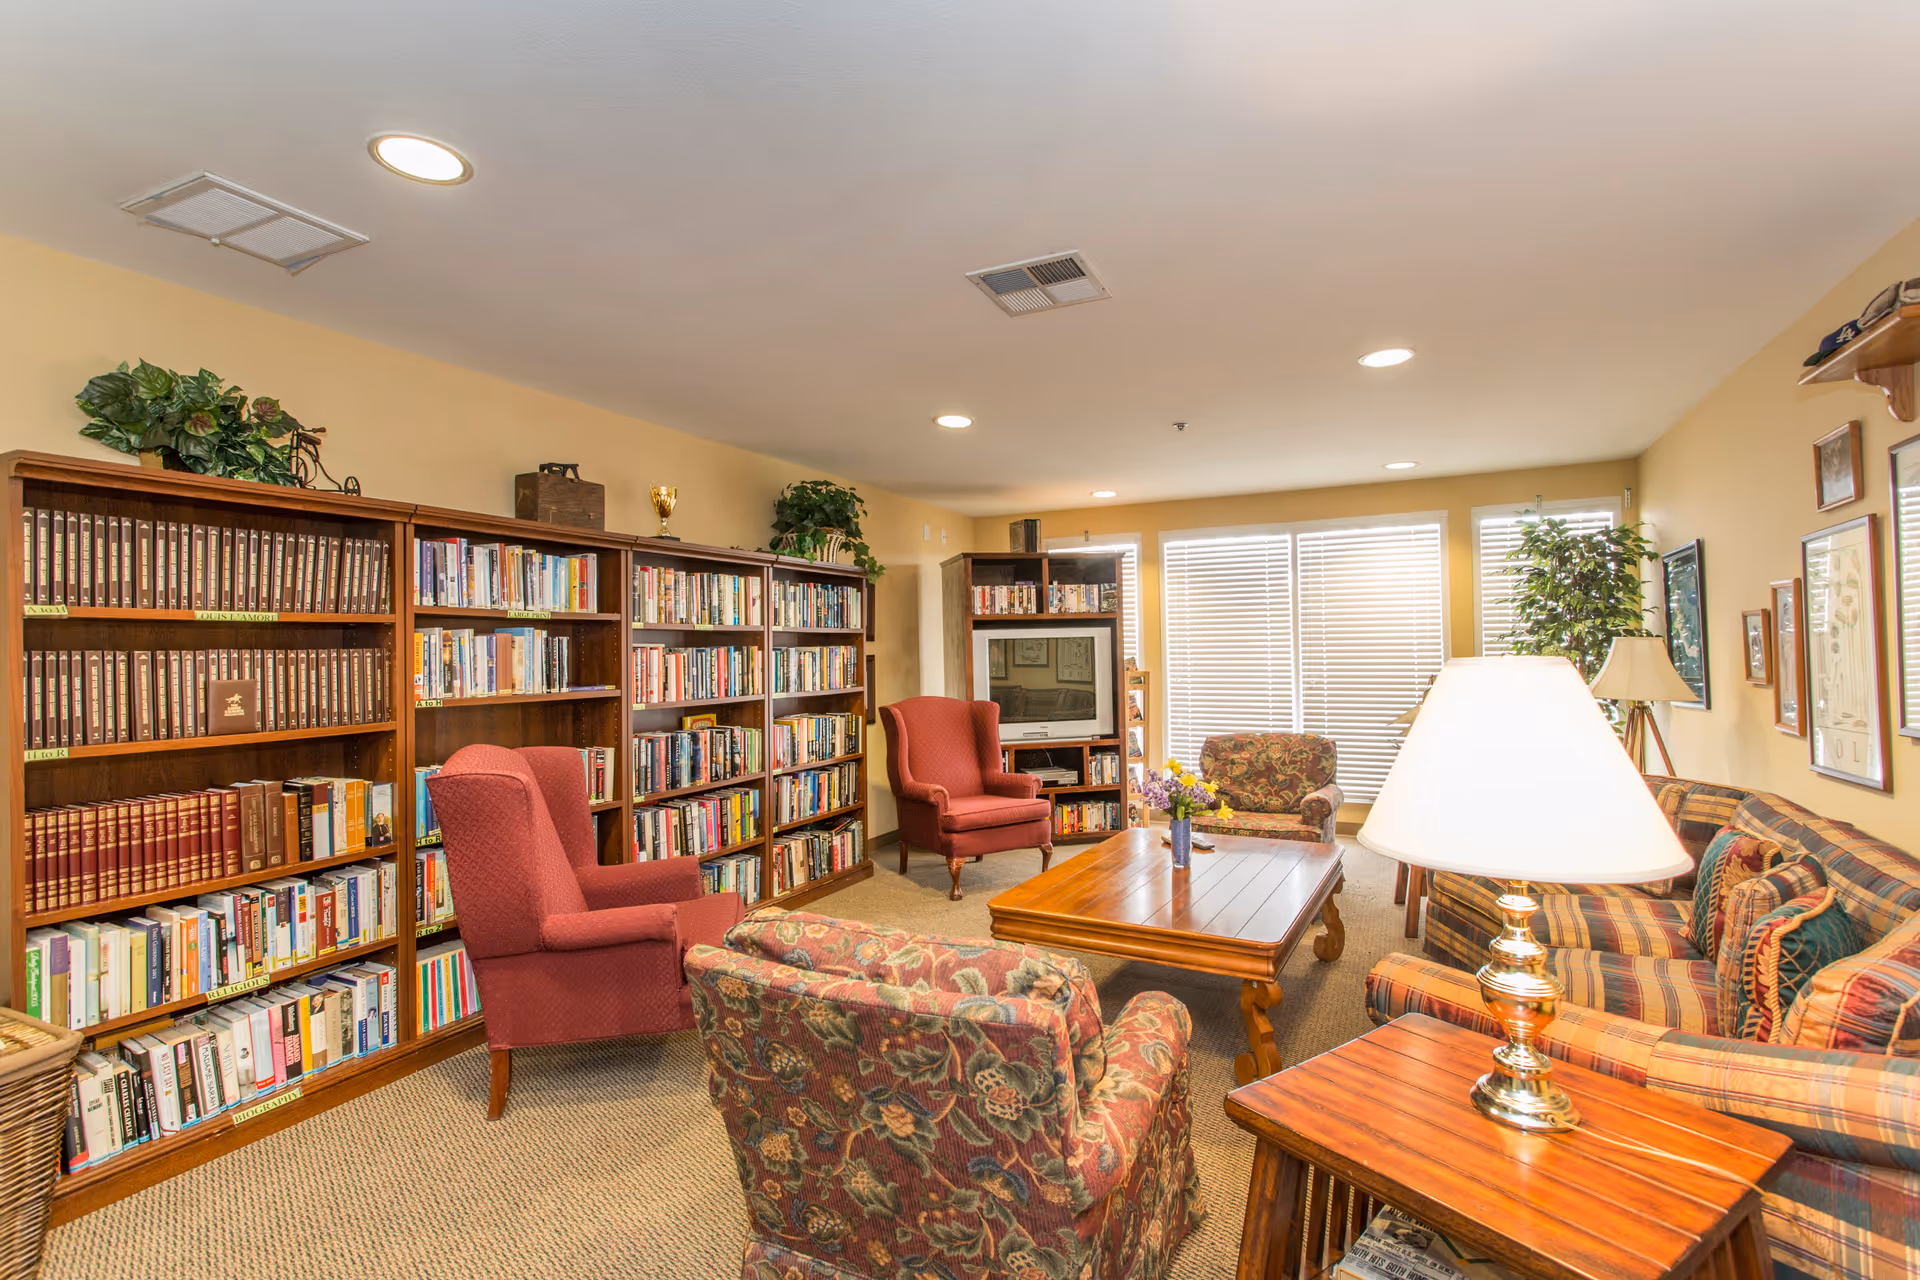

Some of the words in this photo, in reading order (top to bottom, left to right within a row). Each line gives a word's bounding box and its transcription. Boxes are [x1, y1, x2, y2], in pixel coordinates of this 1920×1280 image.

[1836, 325, 1855, 343] LA
[208, 977, 269, 999] RELIGIOUS
[285, 1036, 294, 1067] HAMMER
[293, 1034, 302, 1064] ARMAND
[202, 1046, 212, 1080] MADAME
[207, 1080, 217, 1107] SARAH
[121, 1078, 130, 1108] CHARLES
[234, 1091, 301, 1123] BIOGRAPHY
[125, 1108, 134, 1138] CHAPLIN
[1350, 1246, 1369, 1260] RUTH
[1369, 1252, 1385, 1267] HITS
